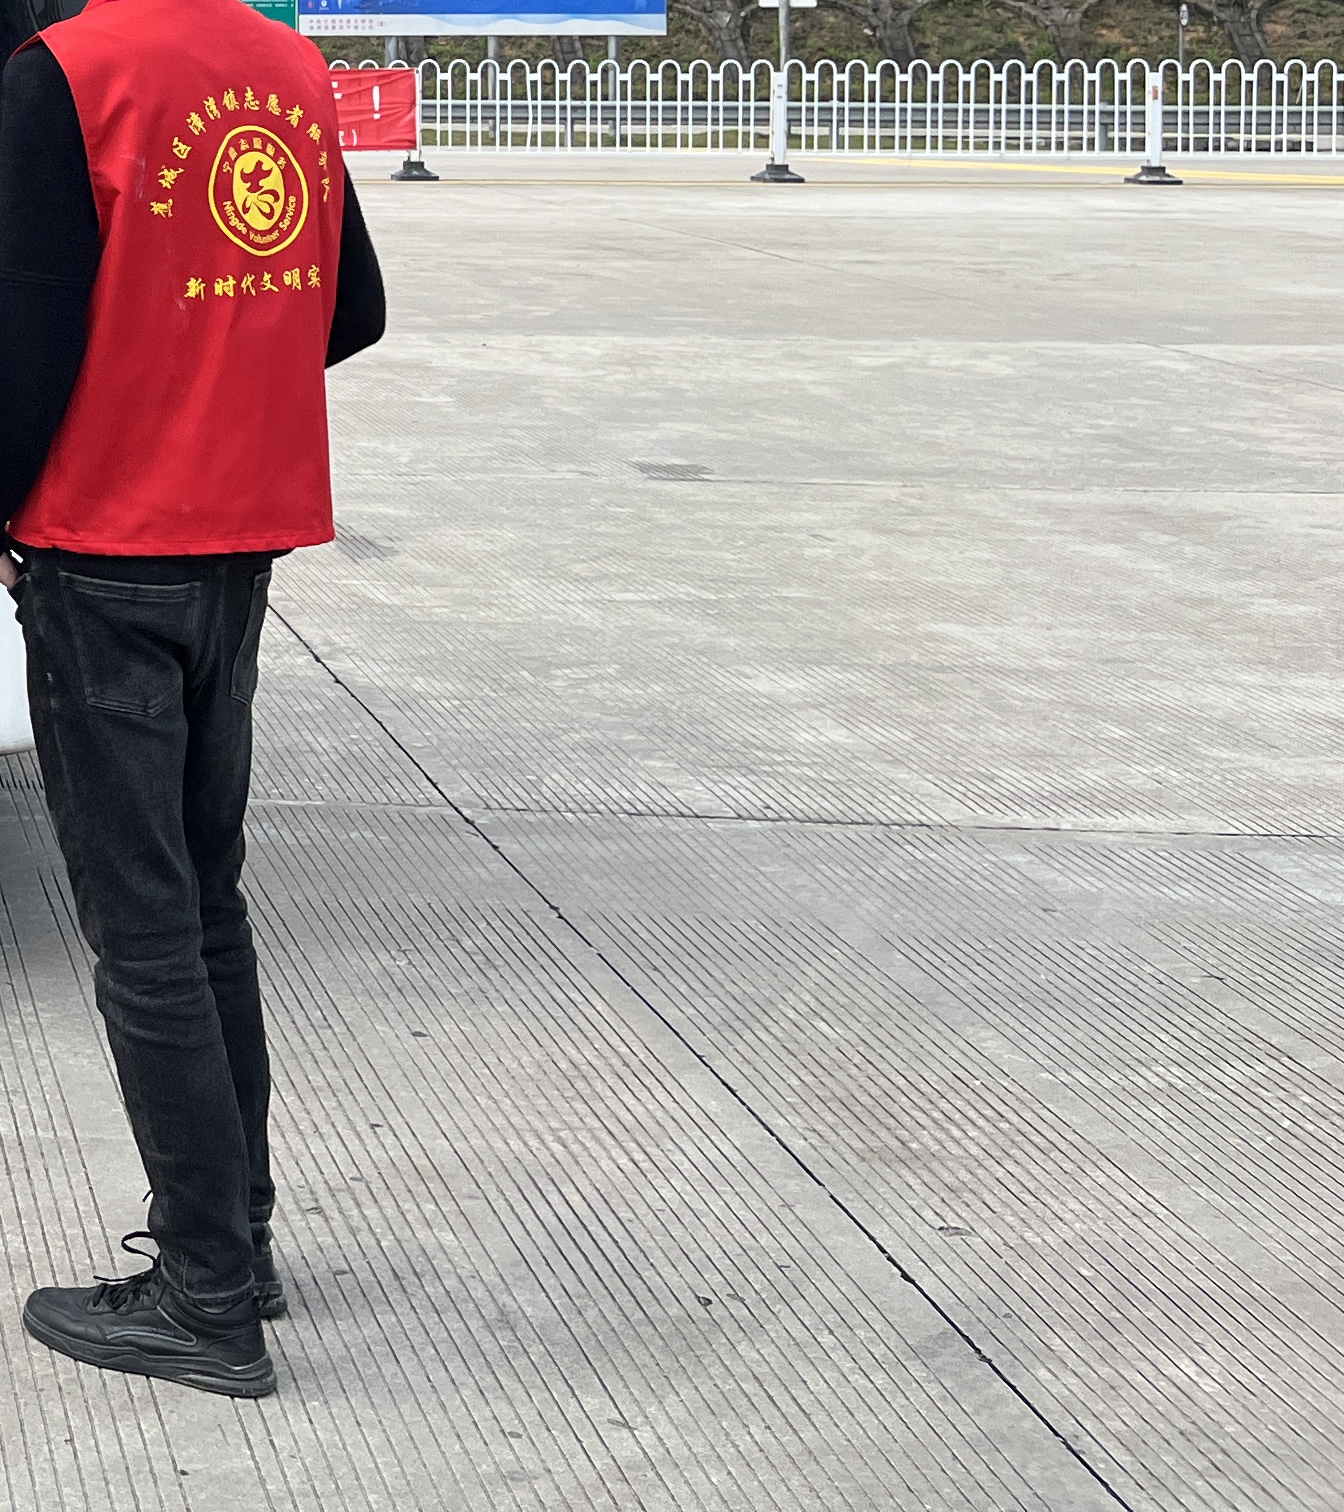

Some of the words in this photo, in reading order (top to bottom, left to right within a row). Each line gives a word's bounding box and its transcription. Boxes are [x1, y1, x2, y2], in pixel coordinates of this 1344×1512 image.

[184, 264, 321, 301] 新时代文明实
